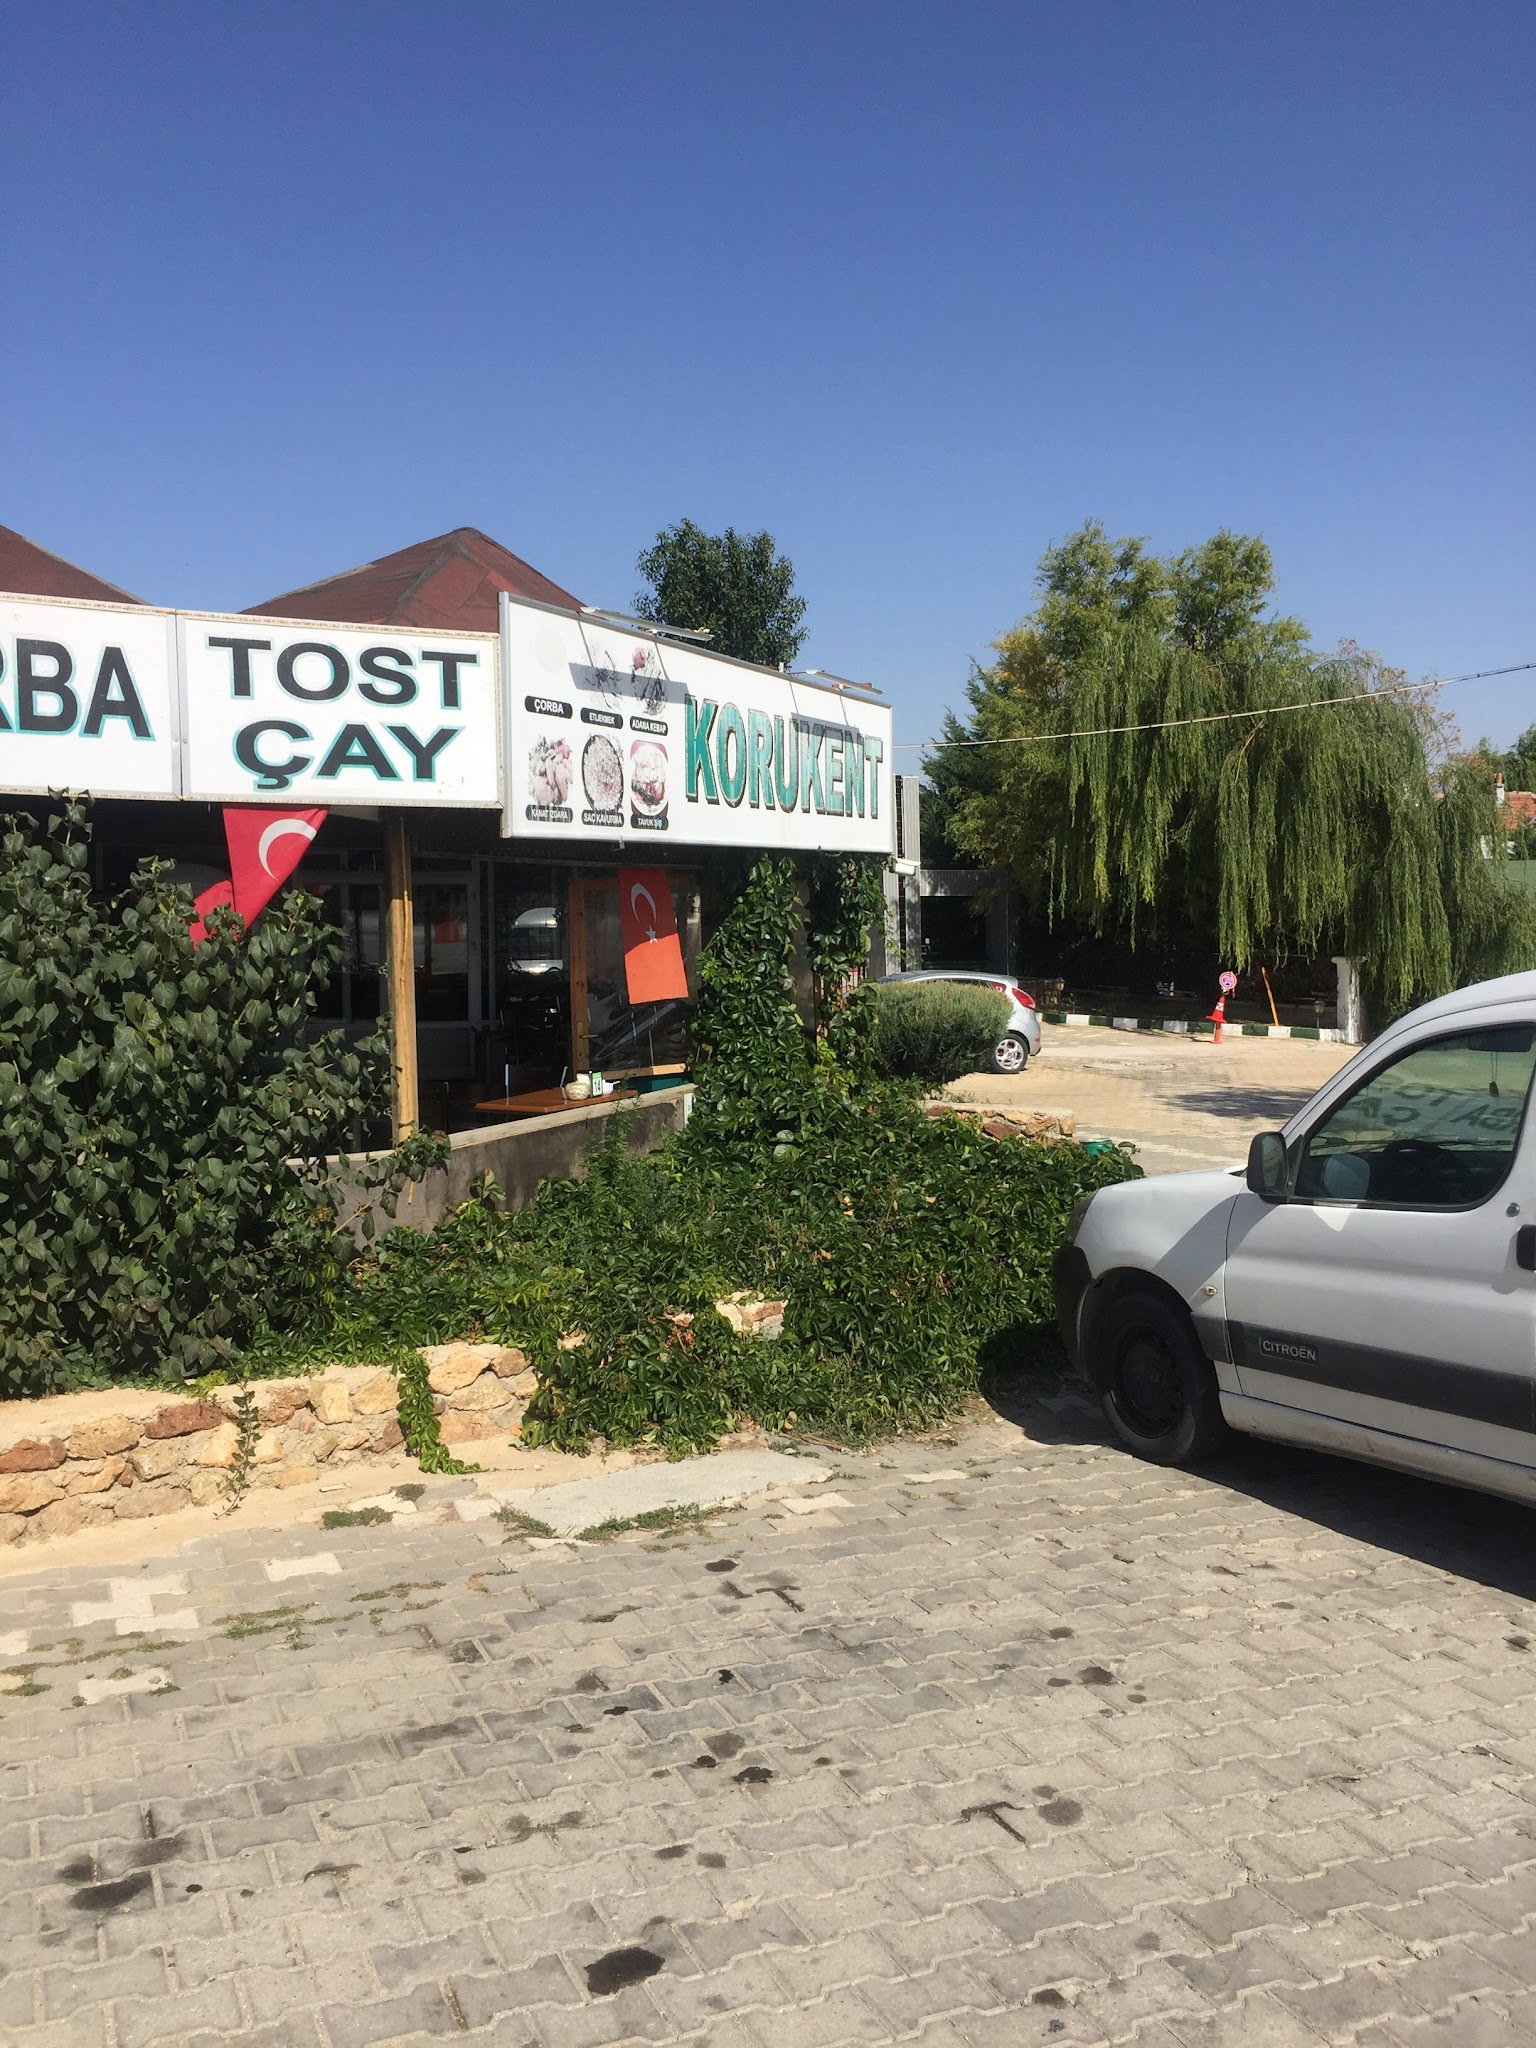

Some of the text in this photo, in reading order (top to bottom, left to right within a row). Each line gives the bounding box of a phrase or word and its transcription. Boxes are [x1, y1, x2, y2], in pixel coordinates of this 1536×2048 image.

[0, 635, 154, 741] BA
[205, 633, 480, 710] TOST
[534, 698, 564, 714] ÇORBA
[233, 718, 466, 793] ÇAY
[684, 693, 883, 819] KORUKENT
